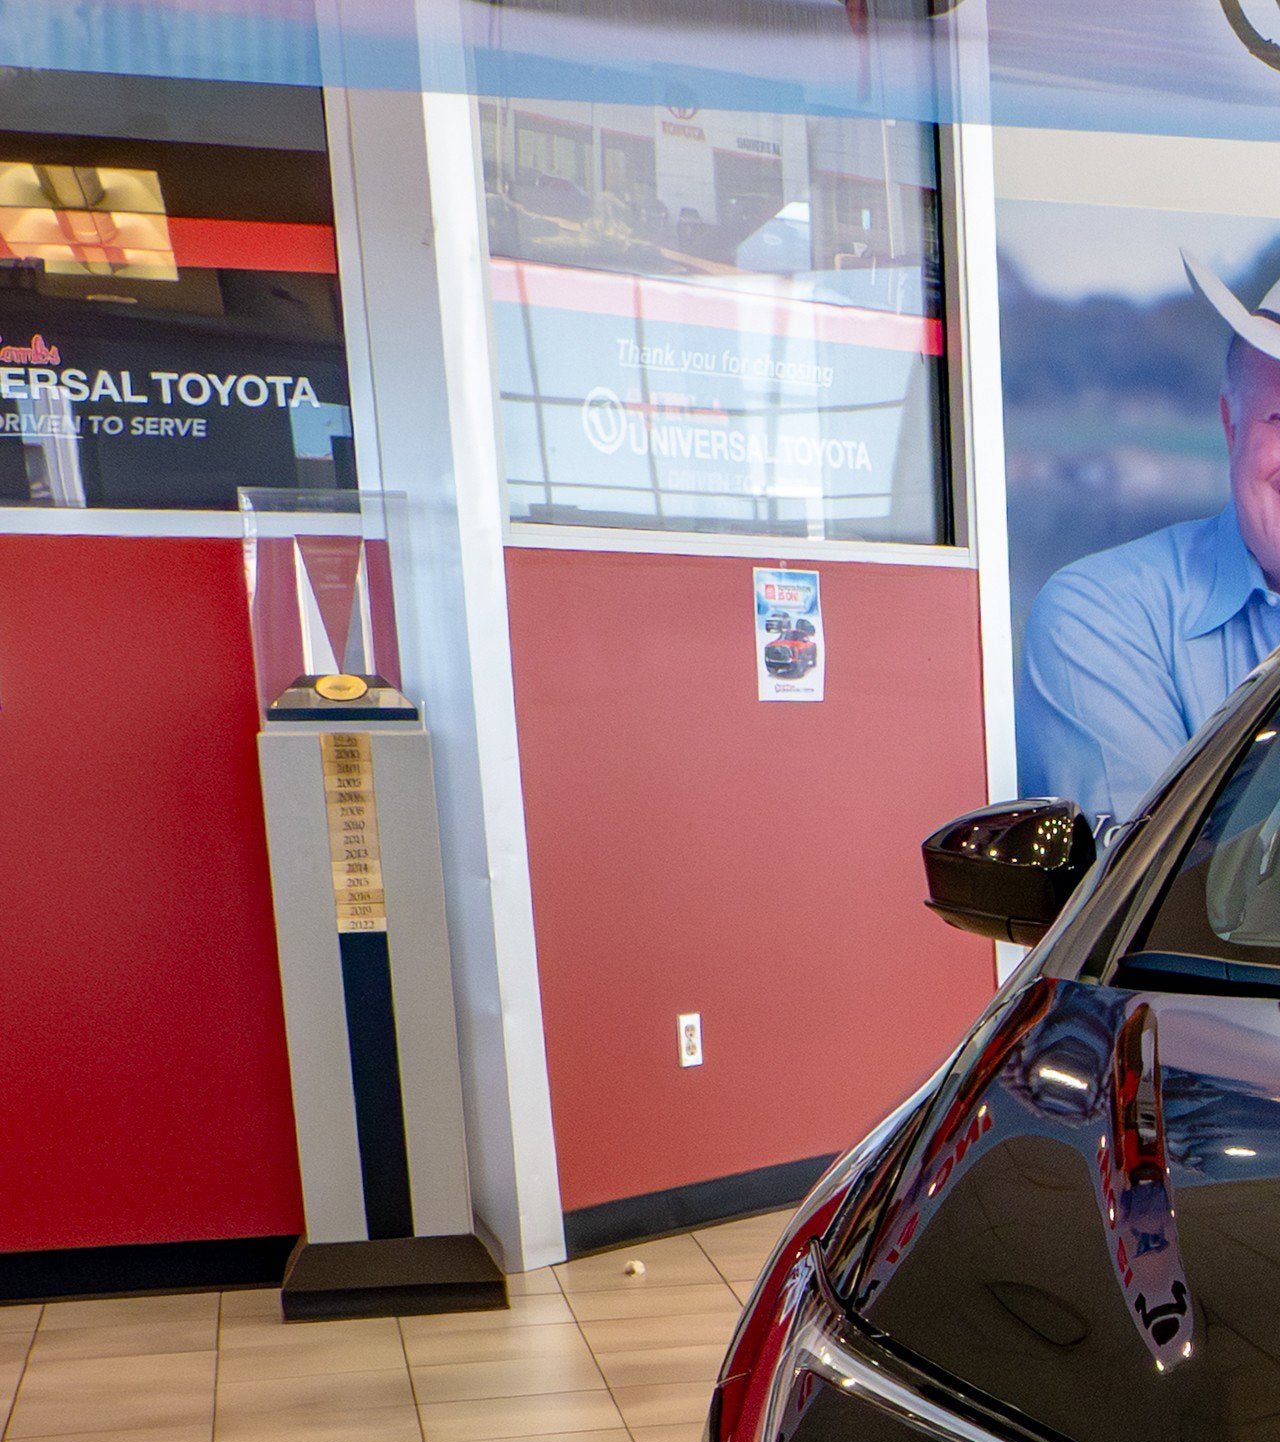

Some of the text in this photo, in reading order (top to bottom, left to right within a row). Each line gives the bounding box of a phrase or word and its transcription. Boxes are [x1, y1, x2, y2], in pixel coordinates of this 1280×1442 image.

[0, 334, 60, 365] ombs
[617, 339, 834, 388] Thank you for choosing
[151, 372, 320, 408] TOYOTA
[88, 416, 123, 435] TO
[131, 417, 207, 438] SERVE
[628, 423, 778, 464] UNIVERSAL
[781, 436, 872, 472] TOYOTA
[350, 920, 374, 930] 2022
